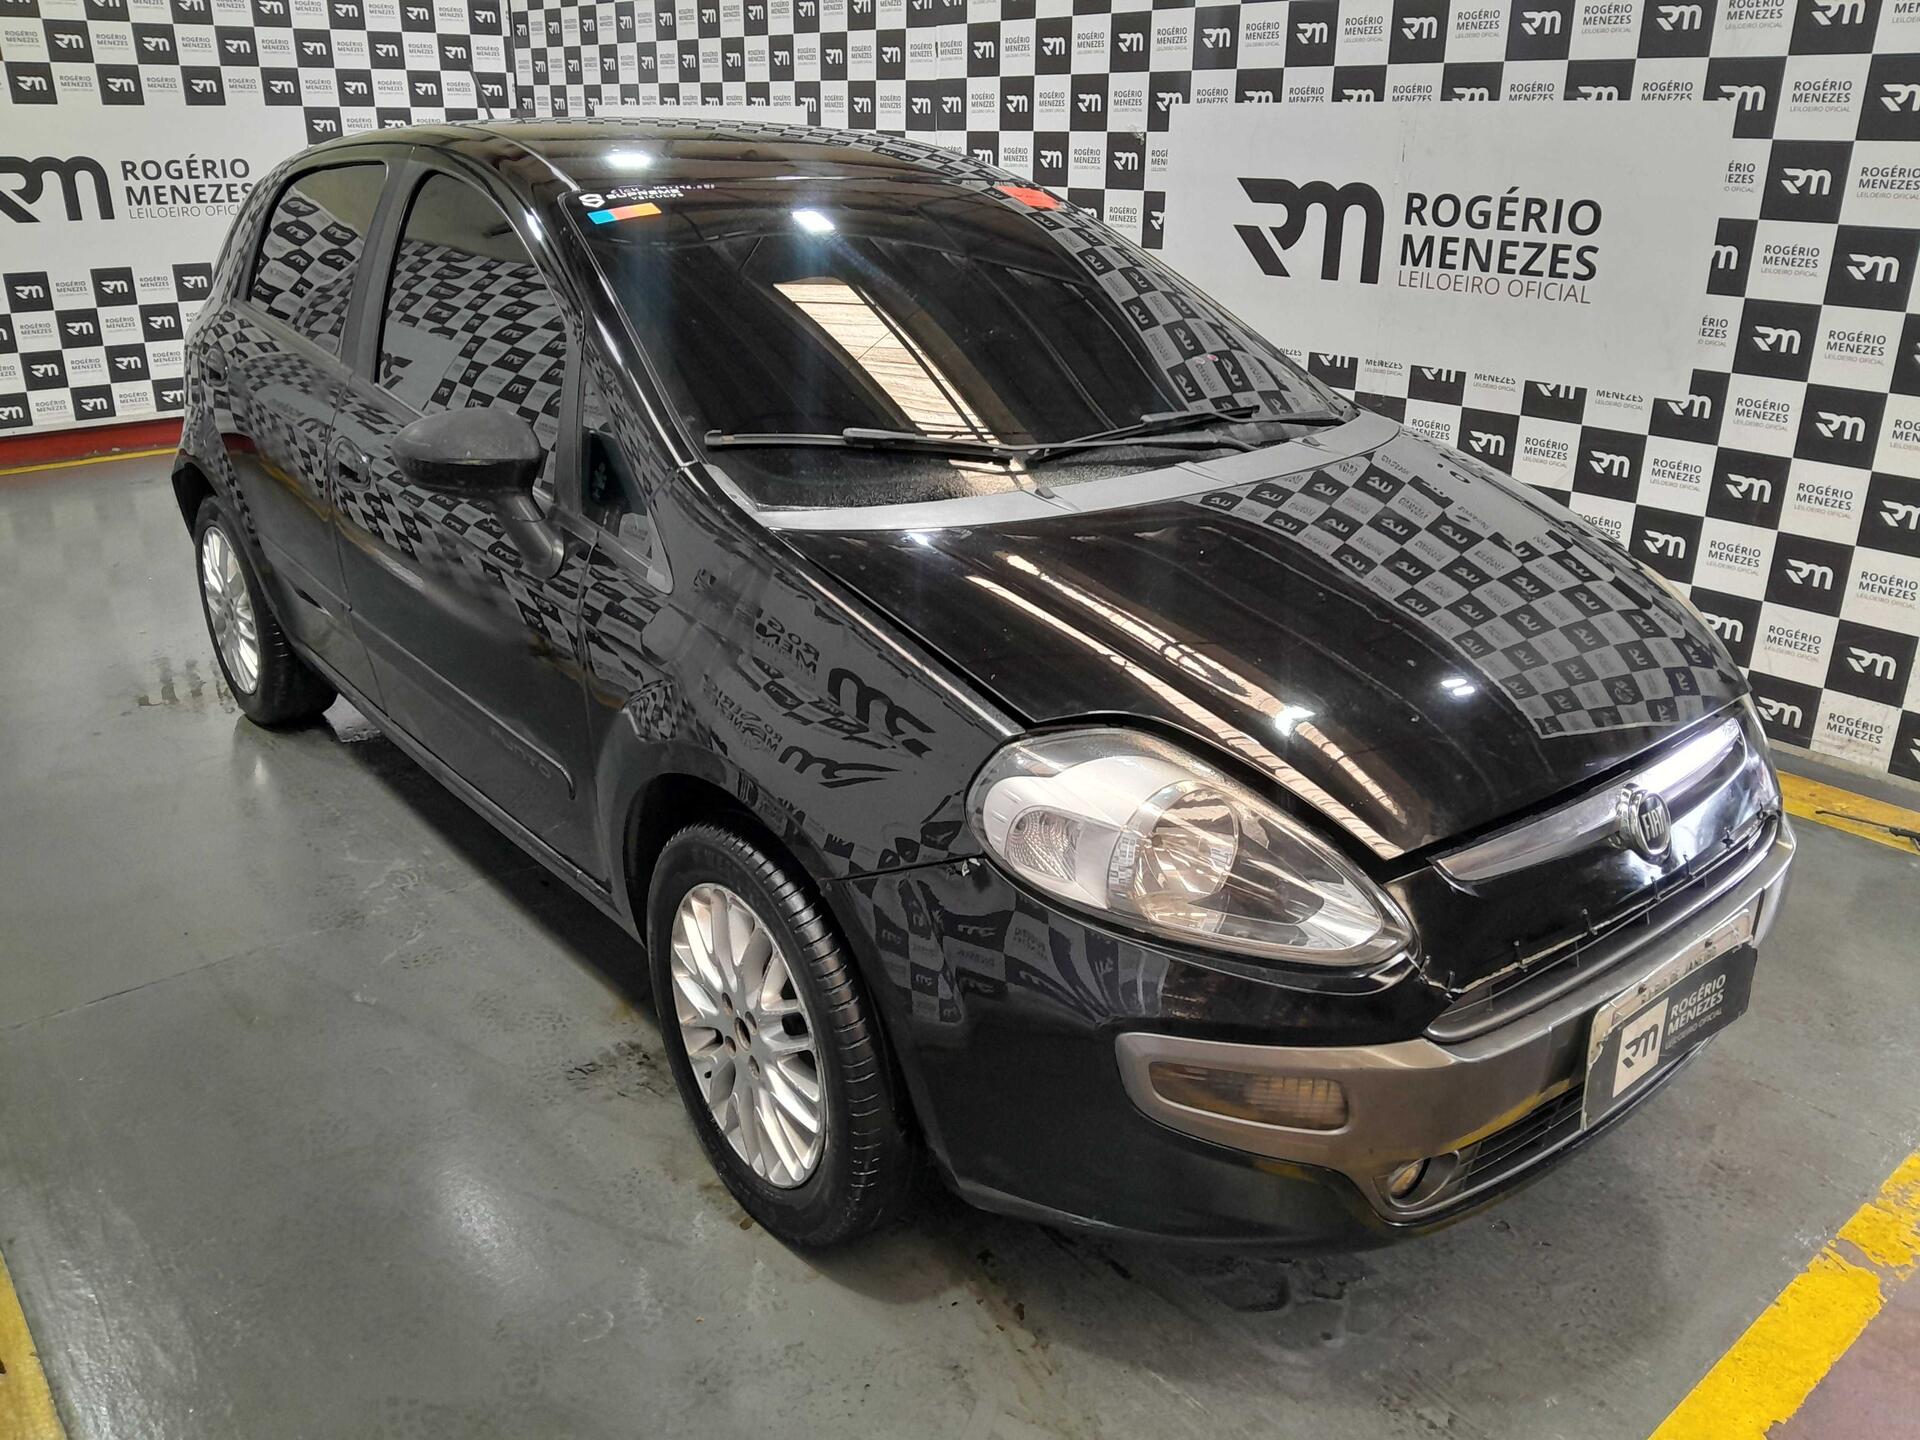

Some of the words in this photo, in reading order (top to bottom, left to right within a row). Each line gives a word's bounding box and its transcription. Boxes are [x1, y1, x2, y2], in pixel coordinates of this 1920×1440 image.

[1457, 8, 1501, 21] ROGÉRIO
[1583, 1, 1633, 15] ROGÉRIO
[1726, 8, 1783, 21] MENEZES
[1246, 20, 1278, 31] ROGÉRIO
[1345, 14, 1382, 26] ROGÉRIO
[1456, 20, 1499, 31] MENEZES
[1582, 14, 1632, 26] MENEZES
[95, 32, 127, 40] ROGÉRIO
[1157, 25, 1187, 36] ROGÉRIO
[1246, 30, 1279, 40] MENEZES
[1345, 25, 1383, 35] MENEZES
[180, 35, 210, 43] ROGÉRIO
[1156, 35, 1187, 45] MENEZES
[146, 75, 176, 83] ROGÉRIO
[1509, 80, 1555, 92] ROGÉRIO
[1642, 79, 1694, 91] ROGÉRIO
[1793, 77, 1853, 91] ROGÉRIO
[1114, 88, 1142, 98] ROGÉRIO
[1196, 86, 1228, 96] ROGÉRIO
[1289, 84, 1324, 95] ROGÉRIO
[1392, 82, 1433, 94] ROGÉRIO
[1113, 98, 1142, 106] MENEZES
[1791, 92, 1851, 103] MENEZES
[120, 154, 250, 182] ROGÉRIO
[1858, 178, 1920, 191] MENEZES
[129, 205, 200, 220] LEILOEIRO
[1404, 186, 1602, 236] ROGÉRIO
[1400, 234, 1599, 281] MENEZES
[1764, 243, 1821, 258] ROGÉRIO
[1762, 255, 1818, 269] MENEZES
[1398, 270, 1500, 295] LEILOEIRO
[1508, 279, 1592, 304] OFICIAL
[19, 322, 51, 330] ROGÉRIO
[105, 316, 135, 324] ROGÉRIO
[106, 321, 136, 329] MENEZES
[1828, 329, 1887, 345] ROGÉRIO
[1826, 341, 1885, 356] MENEZES
[1736, 396, 1791, 413] ROGÉRIO
[1734, 407, 1789, 423] MENEZES
[1411, 418, 1451, 432] ROGÉRIO
[1525, 436, 1569, 451] ROGÉRIO
[1523, 445, 1568, 461] MENEZES
[1652, 457, 1703, 474] ROGÉRIO
[1651, 467, 1701, 484] MENEZES
[1797, 482, 1854, 500] ROGÉRIO
[1795, 492, 1852, 511] MENEZES
[1709, 539, 1762, 558] ROGÉRIO
[1707, 549, 1760, 568] MENEZES
[1860, 570, 1919, 591] ROGÉRIO
[1858, 580, 1917, 601] MENEZES
[1768, 624, 1822, 645] ROGÉRIO
[1766, 634, 1820, 655] MENEZES
[1828, 712, 1884, 735] ROGÉRIO
[1825, 721, 1882, 745] MENEZES
[1671, 974, 1726, 1019] ROGÉRIO
[1668, 990, 1724, 1036] MENEZES
